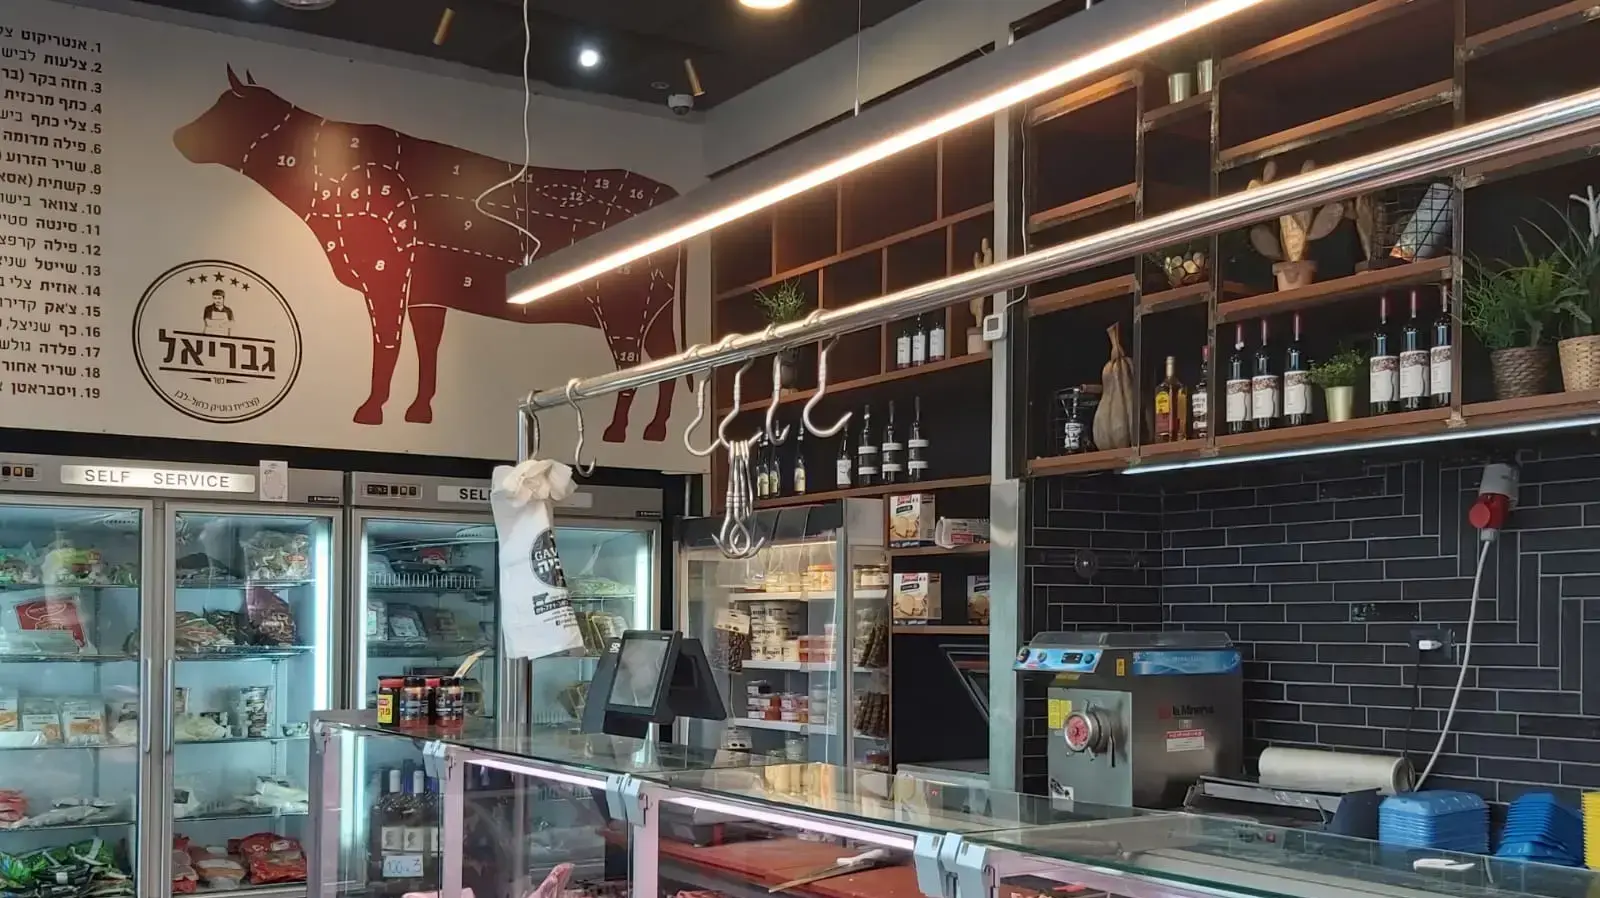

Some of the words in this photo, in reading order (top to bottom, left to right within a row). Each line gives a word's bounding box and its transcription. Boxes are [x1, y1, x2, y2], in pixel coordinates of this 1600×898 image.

[21, 30, 87, 50] אנטריקוט
[90, 43, 101, 53] 1.
[44, 54, 87, 71] צלעות
[90, 62, 102, 73] 2.
[28, 72, 57, 87] בקר
[61, 77, 87, 92] חזה
[90, 82, 102, 94] 3.
[4, 88, 54, 107] מרכזית
[59, 97, 87, 112] כתף
[90, 103, 102, 114] 4.
[31, 114, 60, 128] כתף
[64, 117, 87, 132] צלי
[90, 123, 102, 134] 5.
[3, 130, 49, 147] מדומה
[350, 138, 360, 149] 2
[53, 137, 87, 153] פילה
[90, 143, 102, 155] 6.
[6, 151, 47, 168] הזרוע
[51, 158, 87, 173] שריר
[277, 155, 296, 167] 10
[90, 163, 102, 175] 8.
[452, 165, 461, 176] 1
[36, 177, 87, 196] קשתית
[594, 178, 610, 189] 13
[89, 184, 102, 196] 9.
[321, 190, 331, 201] 9
[350, 188, 360, 199] 6
[381, 185, 391, 196] 5
[569, 191, 583, 201] 12
[629, 189, 644, 200] 16
[39, 197, 78, 213] צוואר
[81, 203, 102, 216] 10.
[35, 218, 78, 233] סינטה
[81, 224, 101, 237] 11.
[397, 219, 408, 230] 4
[463, 220, 473, 231] 9
[43, 238, 78, 253] פילה
[81, 244, 102, 257] 12.
[326, 241, 336, 252] 9
[0, 255, 27, 268] שני
[34, 257, 78, 275] שייטל
[374, 260, 386, 271] 8
[81, 265, 102, 277] 13.
[9, 275, 32, 289] צלי
[39, 281, 78, 295] אוזית
[462, 277, 473, 288] 3
[81, 285, 101, 297] 14.
[81, 306, 101, 318] 15.
[59, 324, 78, 338] כף
[81, 326, 101, 338] 16.
[39, 342, 78, 356] פלדה
[81, 347, 101, 358] 17.
[158, 328, 277, 373] גבריאל
[619, 352, 635, 362] 18
[40, 363, 78, 377] שריר
[80, 367, 101, 379] 18.
[11, 382, 77, 398] ויסבראטן
[80, 387, 101, 399] 19.
[84, 469, 130, 483] SELF
[153, 472, 230, 488] SERVICE
